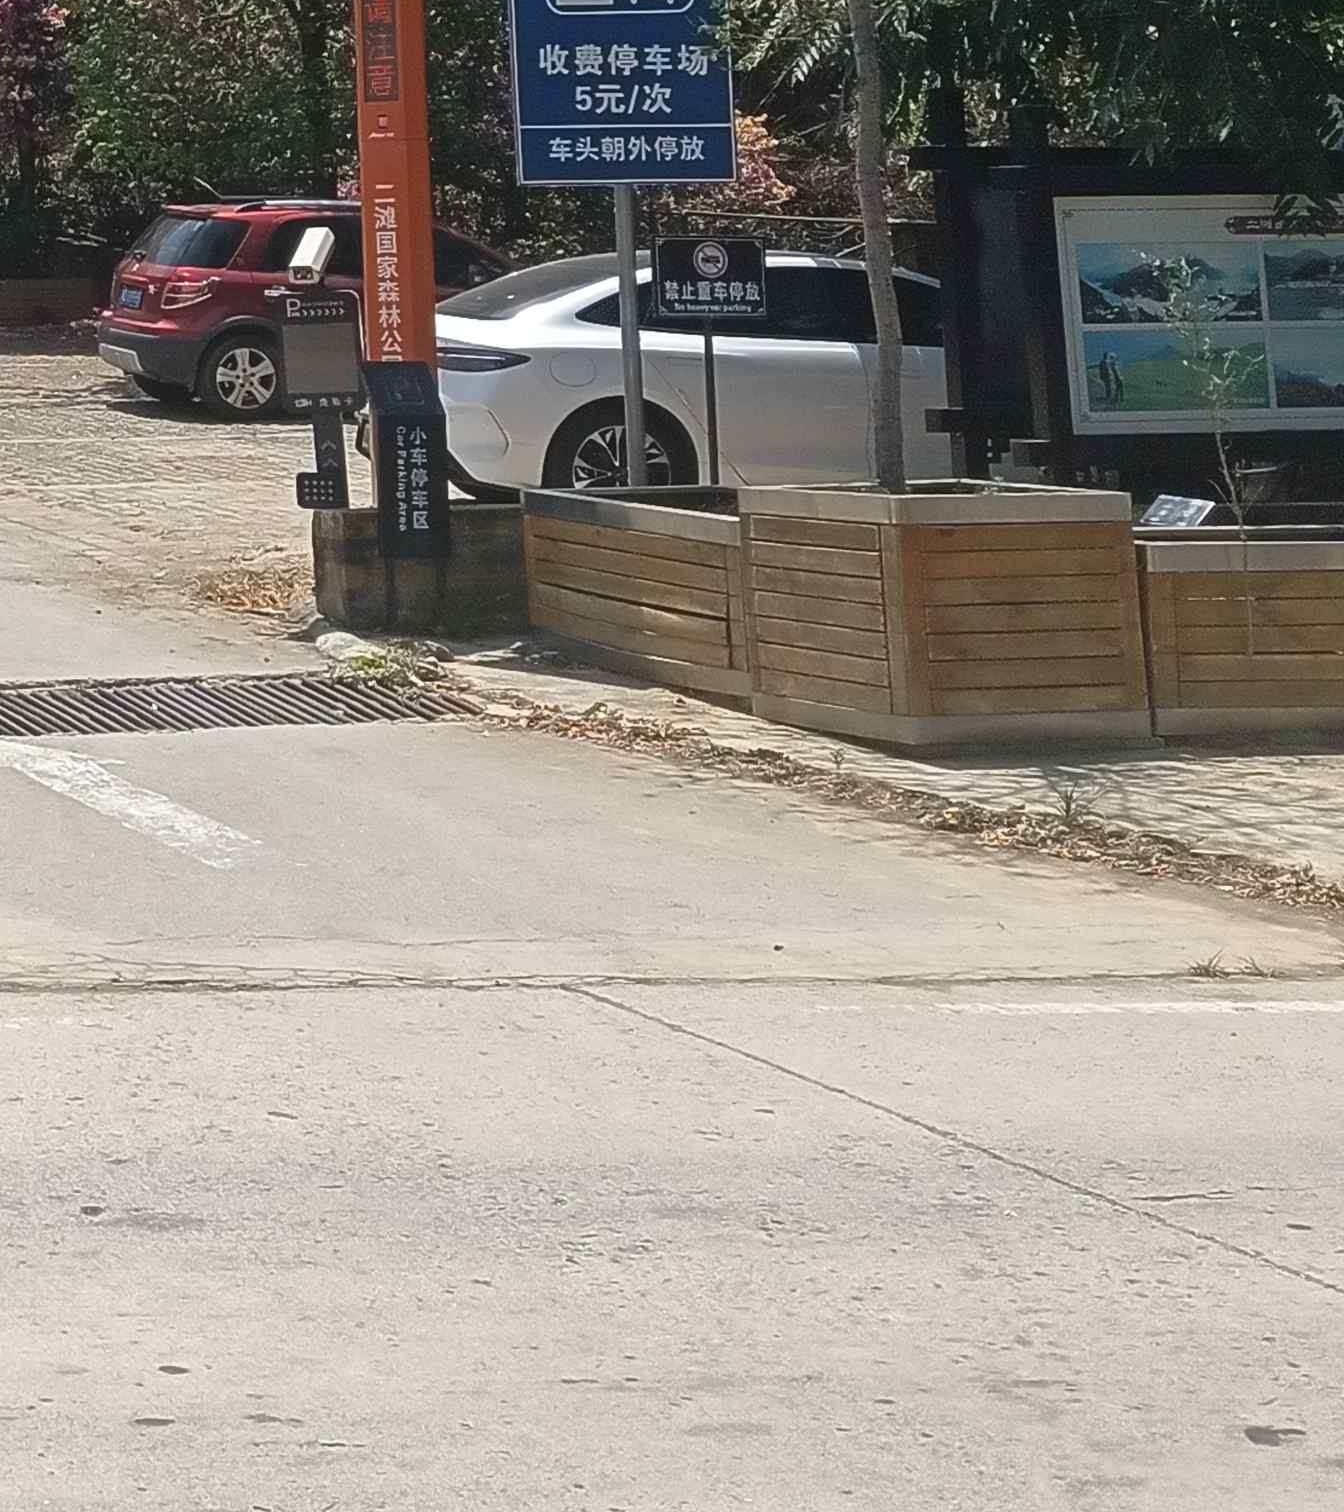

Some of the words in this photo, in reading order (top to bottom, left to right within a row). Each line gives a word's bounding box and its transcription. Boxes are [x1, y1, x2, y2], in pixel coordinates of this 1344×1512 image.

[538, 44, 709, 76] 收费停车场
[575, 83, 672, 115] 5元/次
[549, 135, 705, 163] 车头朝外停放
[664, 280, 761, 302] 禁止重车停放
[410, 426, 430, 529] 小车停车区
